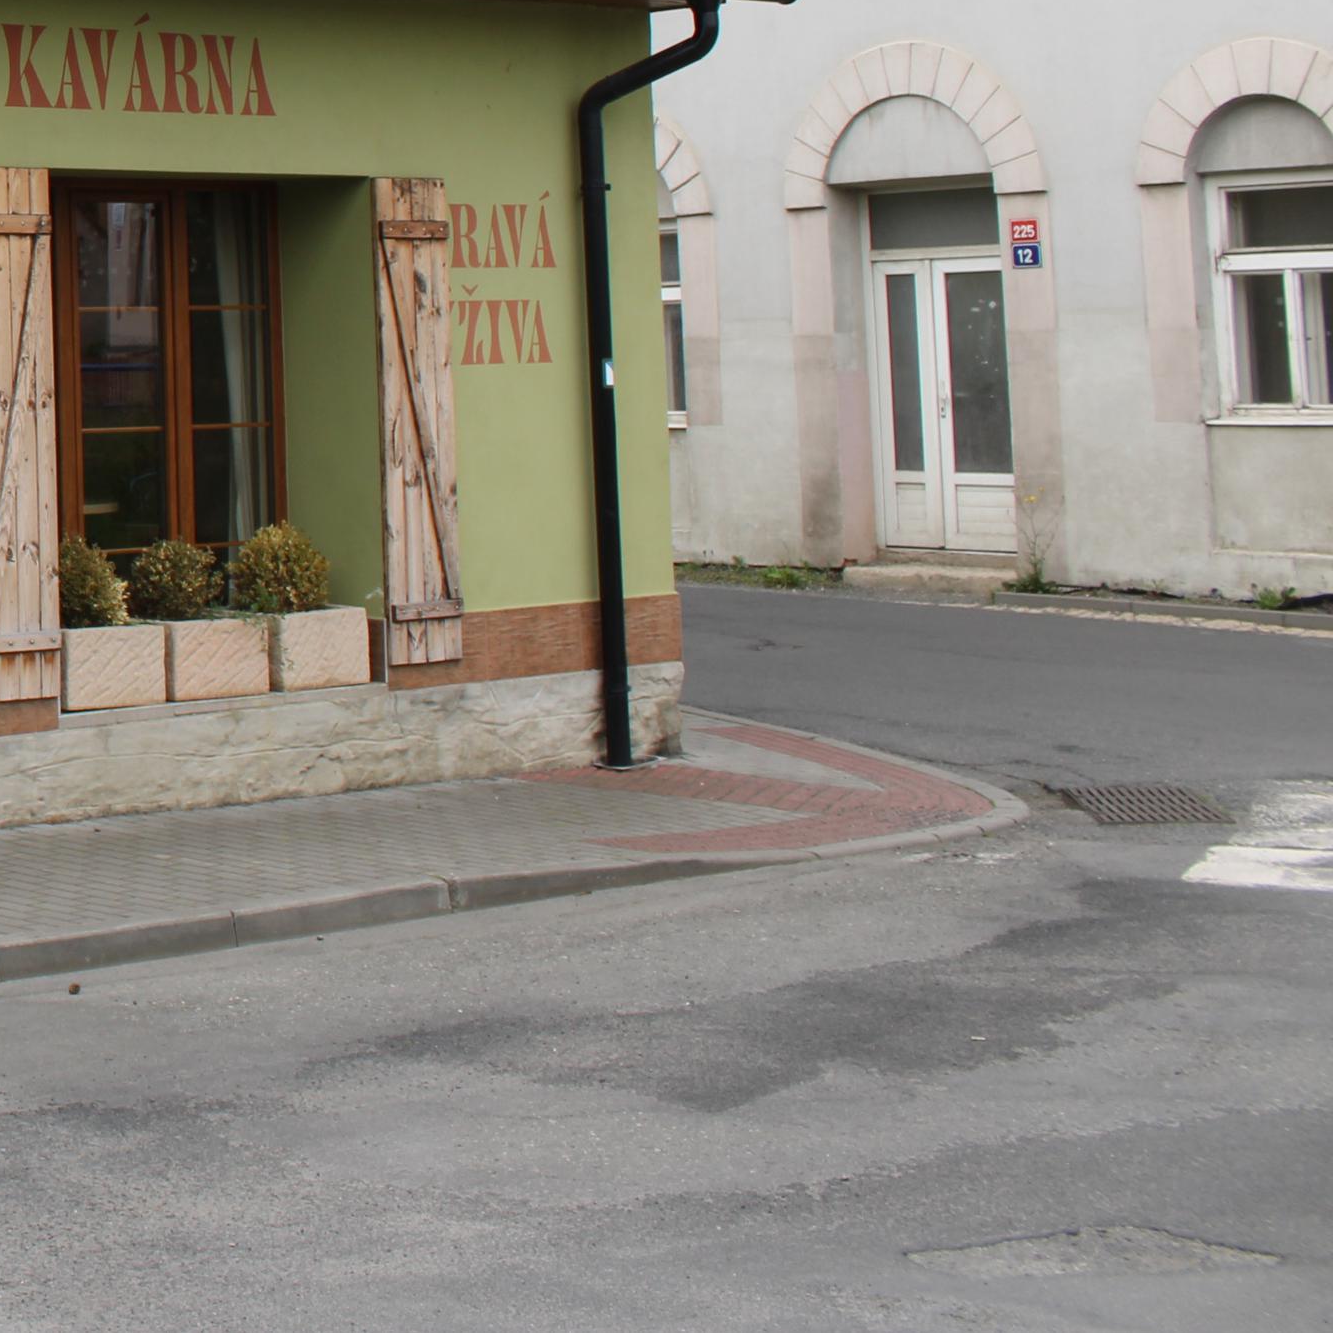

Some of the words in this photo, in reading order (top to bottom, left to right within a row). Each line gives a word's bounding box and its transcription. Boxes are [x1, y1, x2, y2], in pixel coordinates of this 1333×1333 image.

[1, 12, 278, 117] KAVÁRNA
[449, 190, 558, 268] RAVÁ
[1013, 224, 1035, 238] 225
[1017, 249, 1033, 264] 12
[449, 284, 553, 365] ŽIVA
